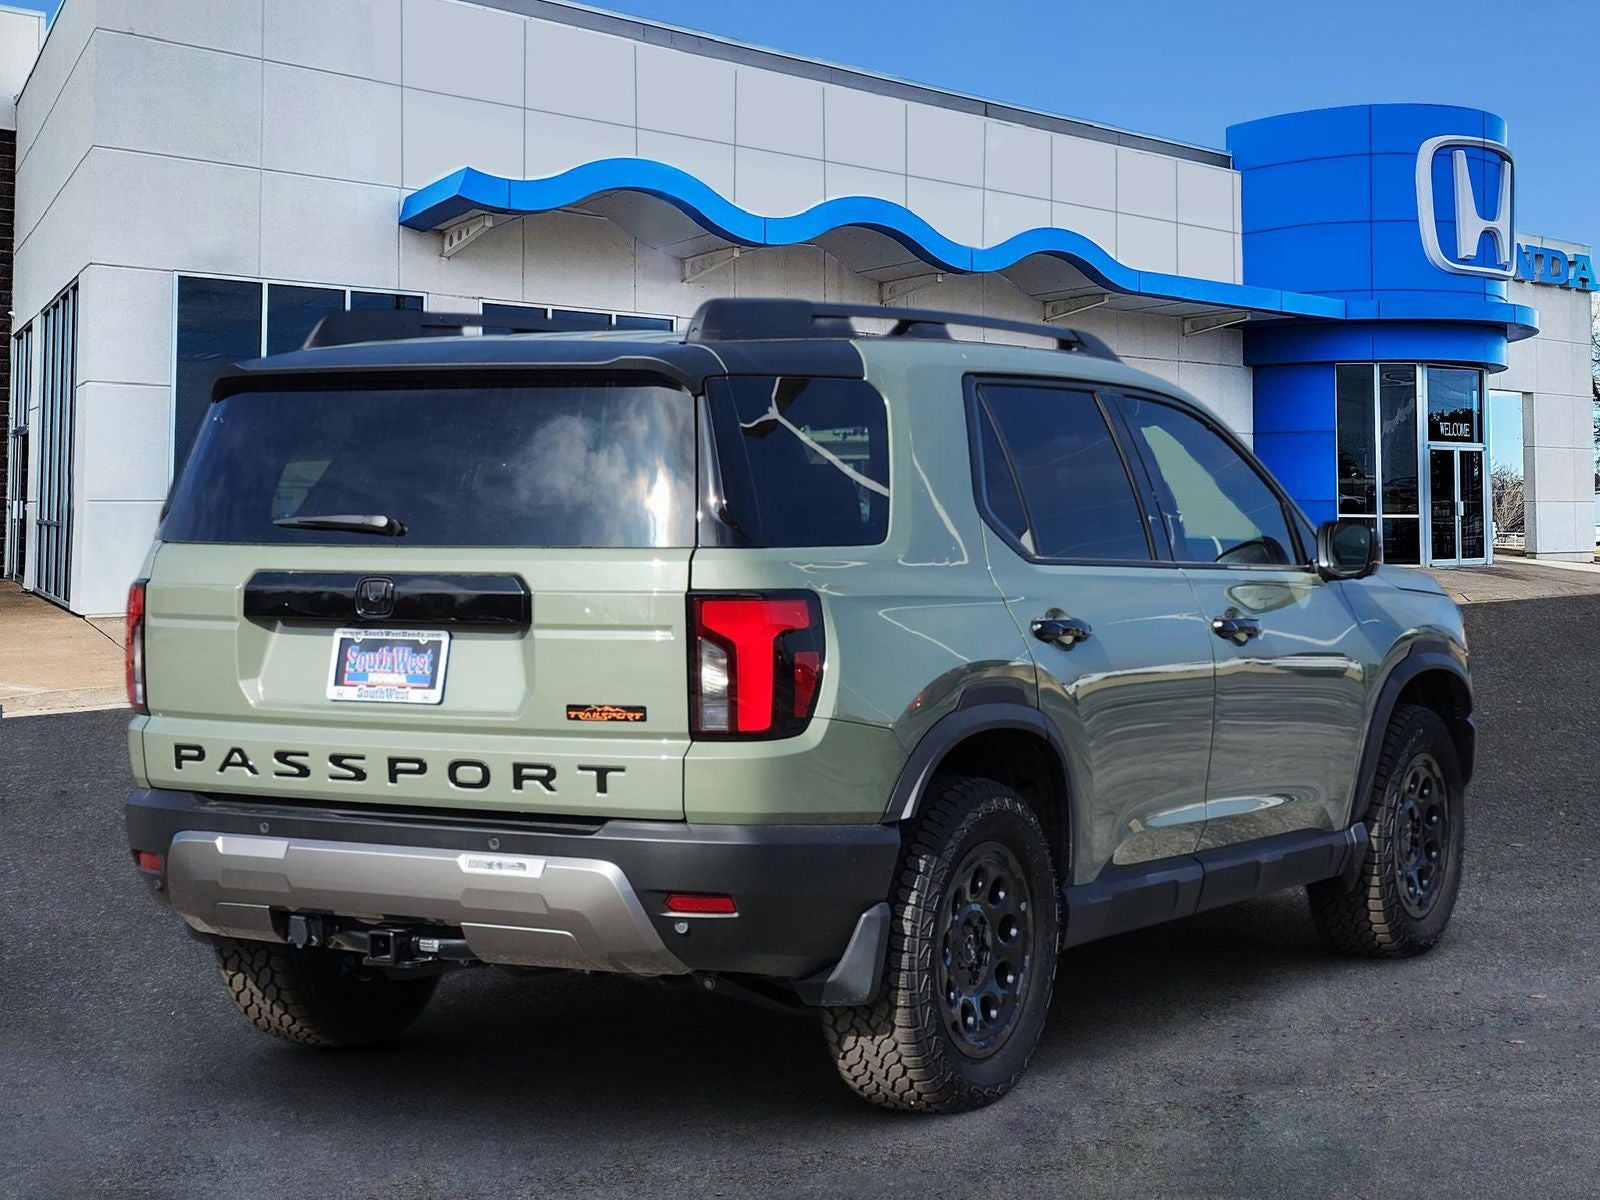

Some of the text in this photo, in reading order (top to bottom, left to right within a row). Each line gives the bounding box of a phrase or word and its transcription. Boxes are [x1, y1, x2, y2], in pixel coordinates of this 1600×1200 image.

[1439, 422, 1471, 437] WELCOME
[567, 711, 645, 722] TRAILSPORT
[173, 743, 627, 796] PASSPORT
